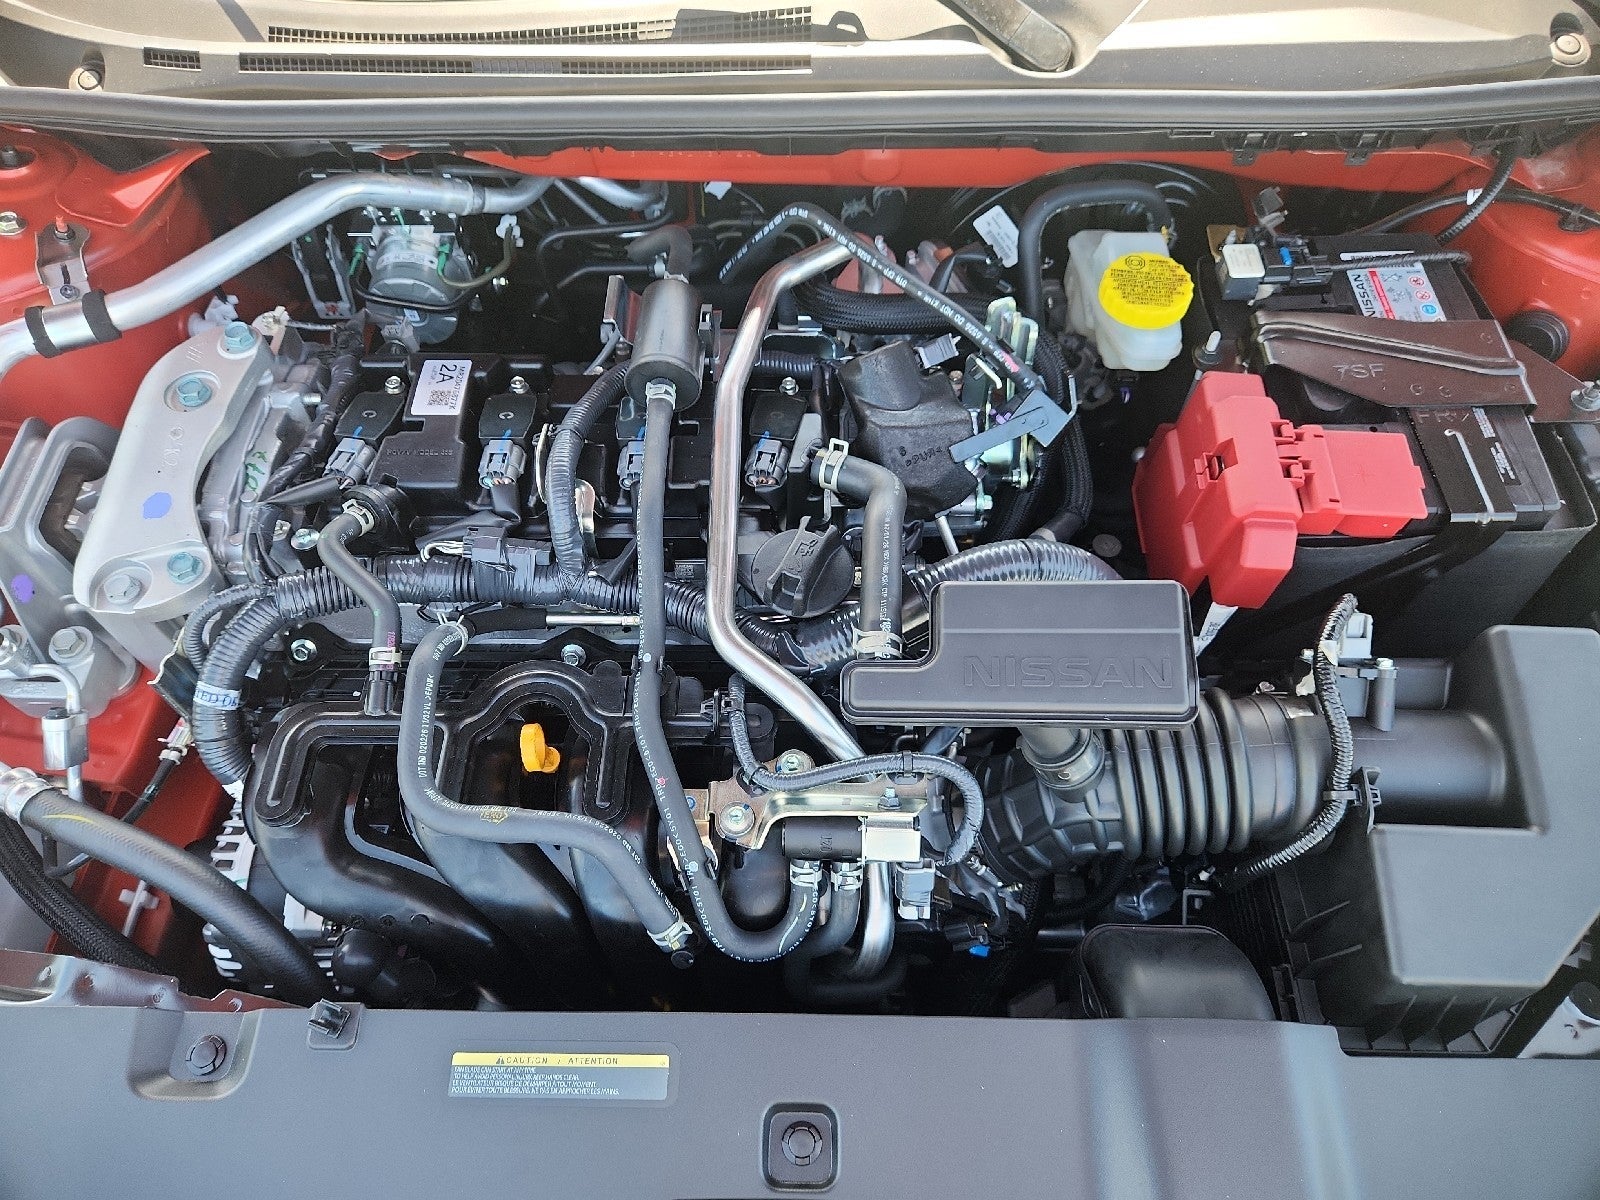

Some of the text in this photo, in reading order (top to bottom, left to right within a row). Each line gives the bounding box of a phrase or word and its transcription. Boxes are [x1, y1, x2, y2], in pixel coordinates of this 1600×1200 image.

[1351, 273, 1376, 317] NISSAN
[436, 364, 458, 384] 2A
[964, 656, 1173, 688] NISSAN
[568, 1057, 618, 1065] ATTENTION
